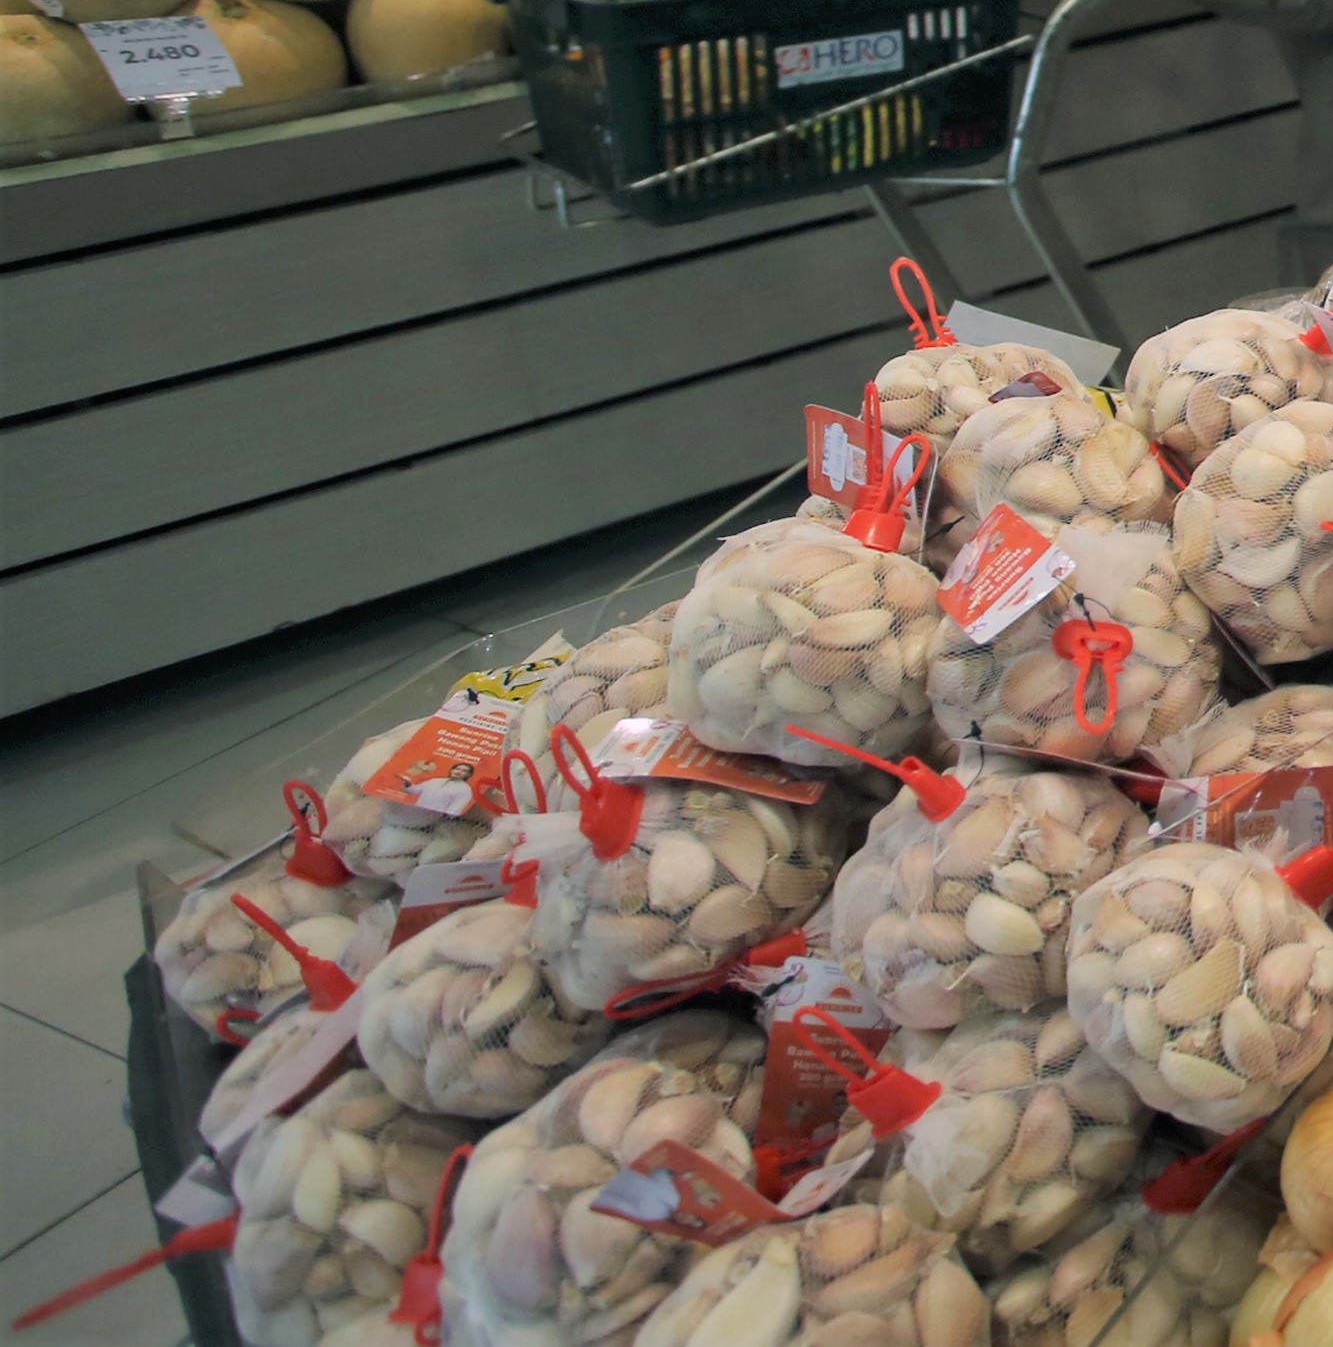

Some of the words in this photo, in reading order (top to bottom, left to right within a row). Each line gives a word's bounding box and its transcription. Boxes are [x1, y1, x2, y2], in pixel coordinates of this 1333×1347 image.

[119, 44, 200, 65] 2.480
[814, 34, 898, 69] HERO
[458, 726, 500, 742] Sunrise
